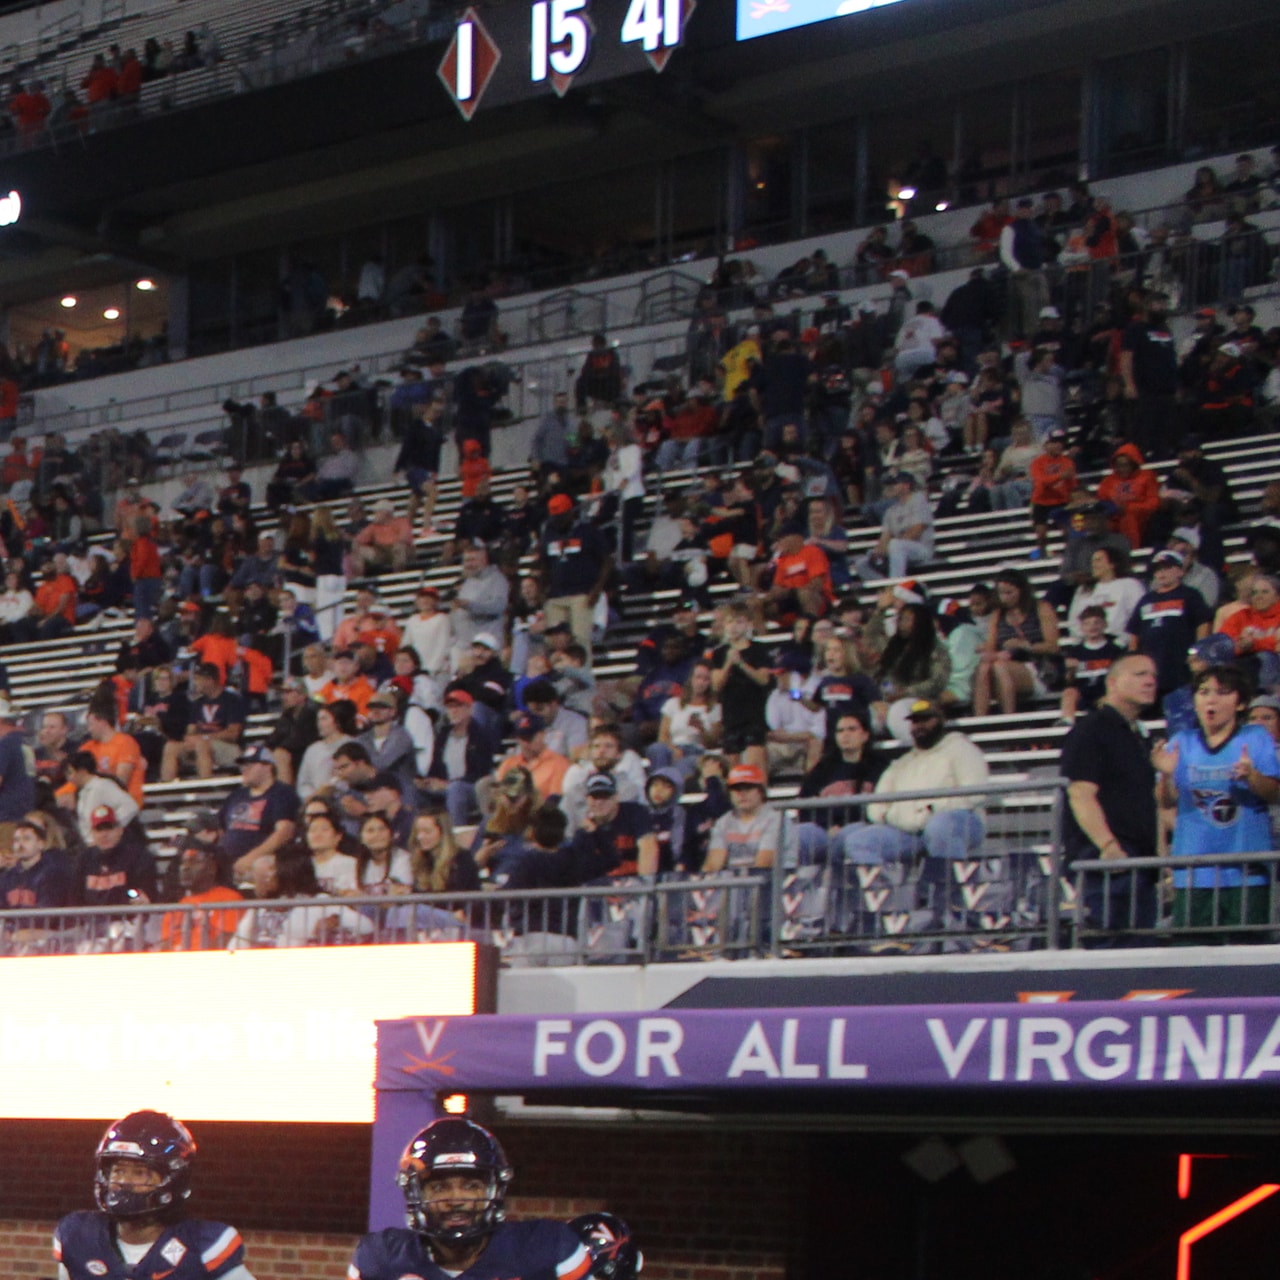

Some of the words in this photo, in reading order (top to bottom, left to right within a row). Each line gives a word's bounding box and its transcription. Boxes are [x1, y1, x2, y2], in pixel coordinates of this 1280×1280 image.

[531, 0, 588, 83] 15
[620, 0, 680, 52] 41
[531, 1018, 685, 1078] FOR
[726, 1017, 869, 1080] ALL
